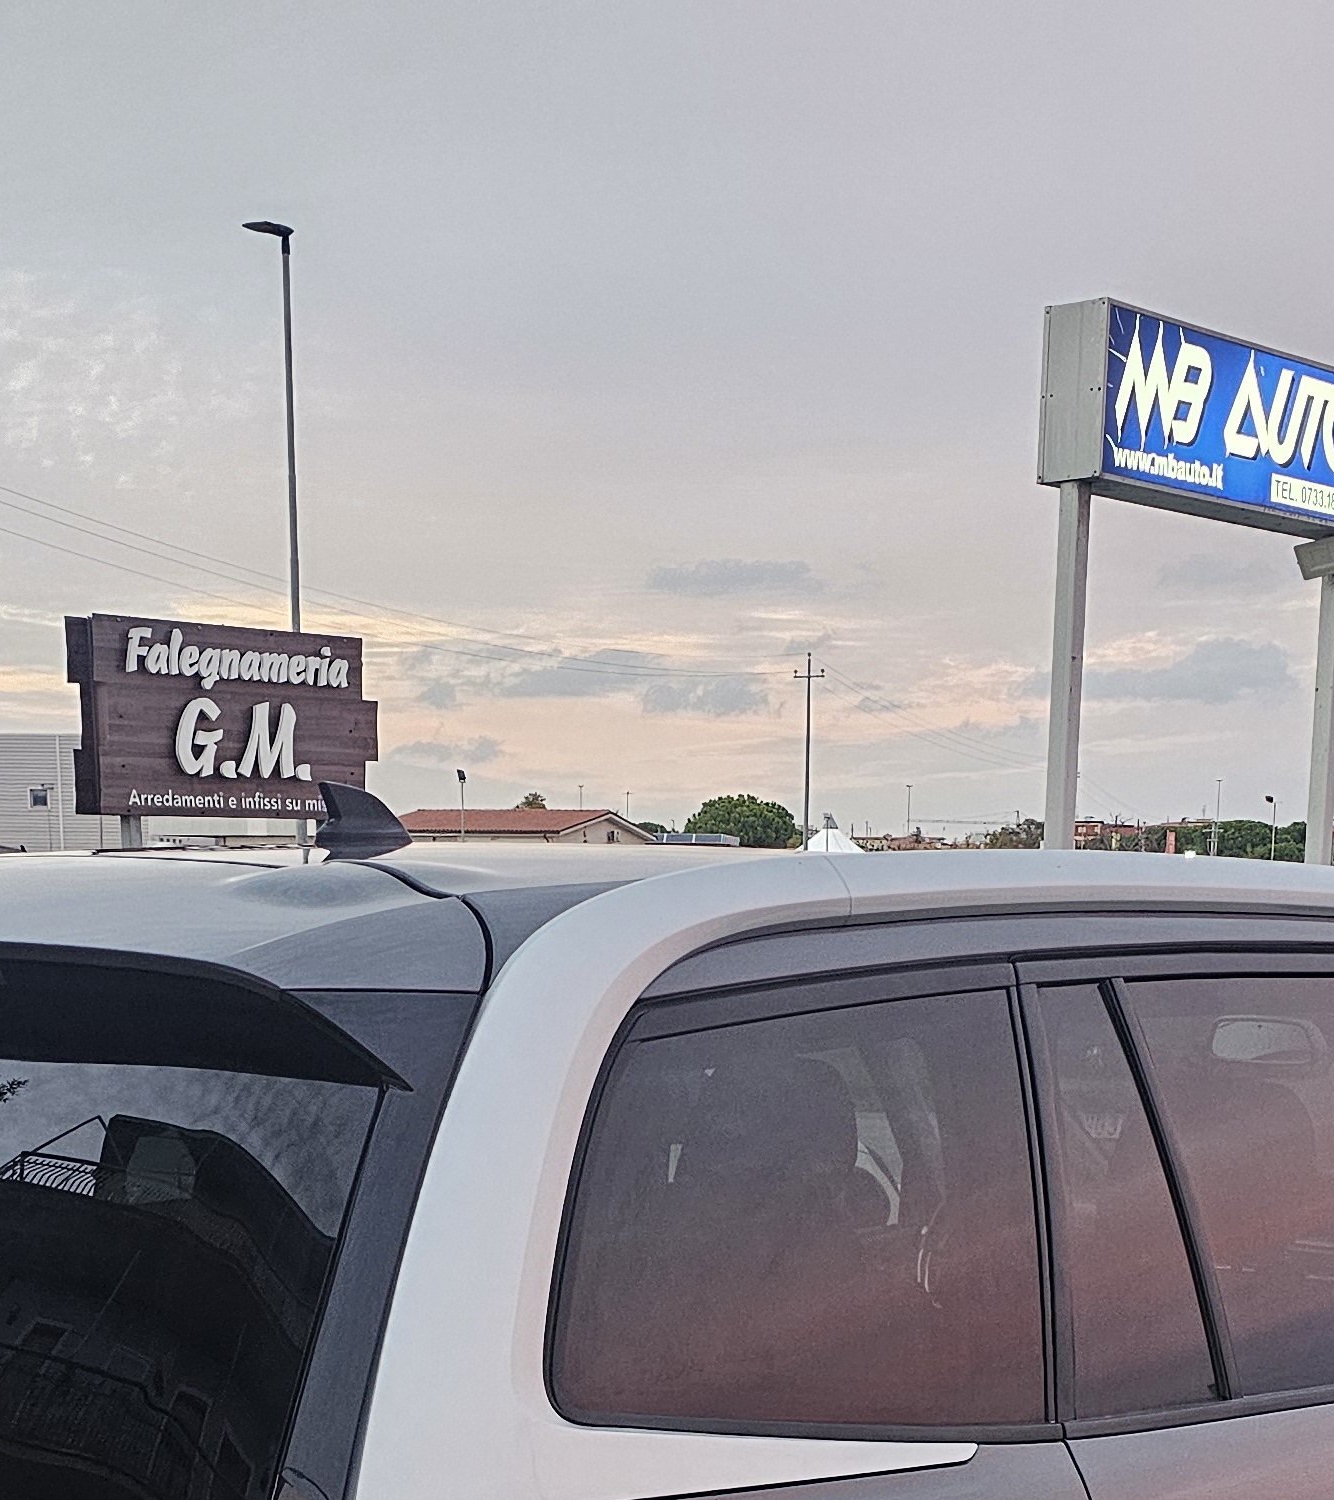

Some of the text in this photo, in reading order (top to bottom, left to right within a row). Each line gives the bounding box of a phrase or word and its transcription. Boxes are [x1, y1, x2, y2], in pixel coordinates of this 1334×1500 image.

[1274, 479, 1298, 503] TEL.
[124, 627, 349, 690] Falegnameria
[175, 697, 313, 781] G.M.
[128, 788, 225, 809] Arredamenti
[228, 797, 238, 809] e
[241, 791, 283, 811] infissi
[285, 798, 302, 811] su
